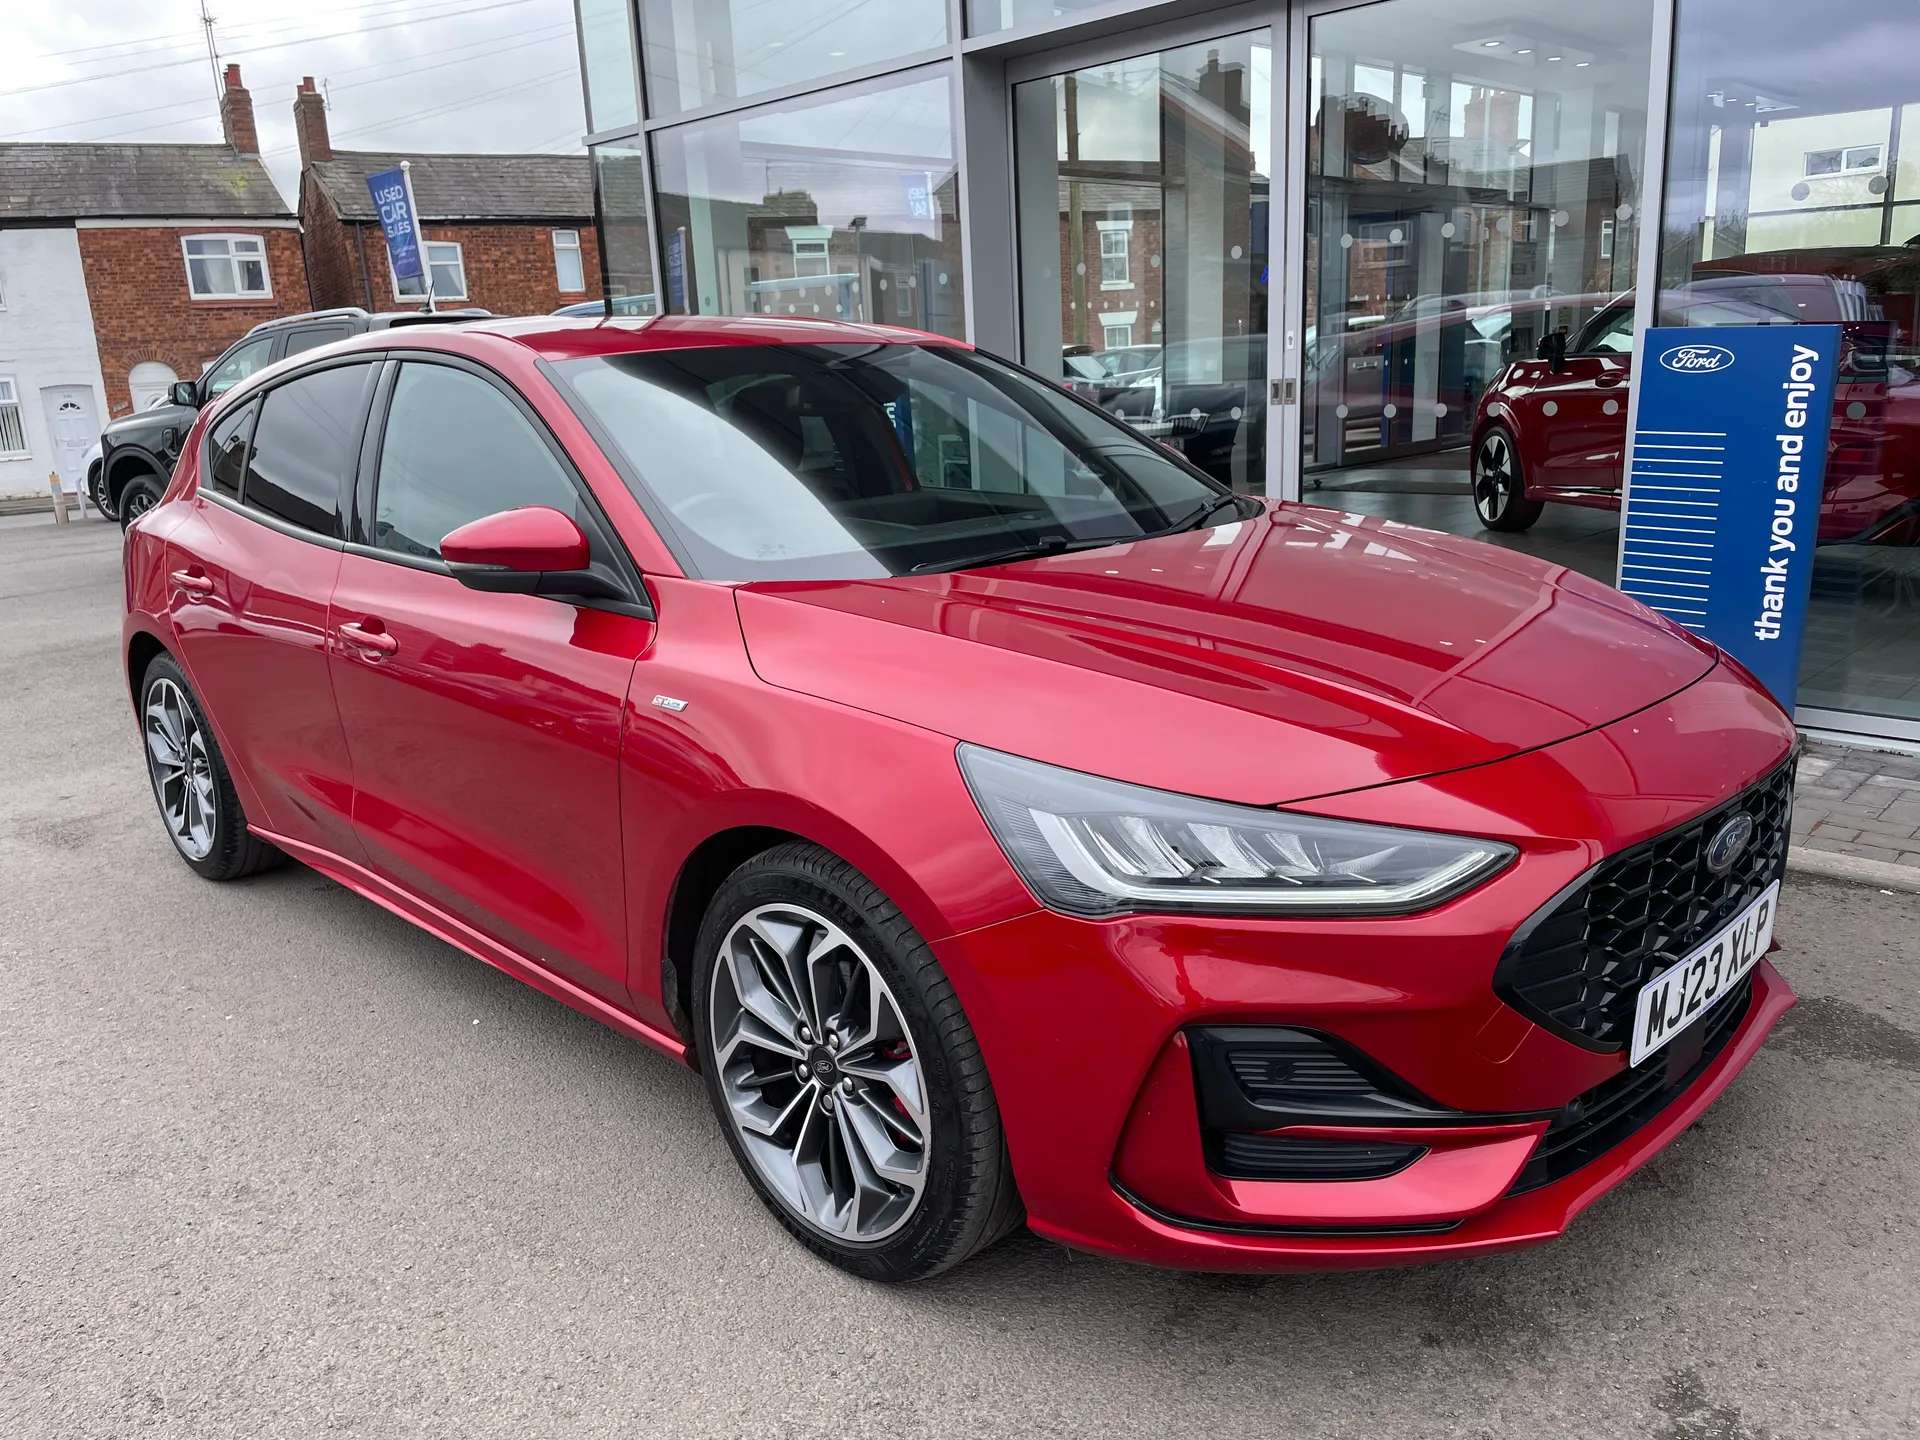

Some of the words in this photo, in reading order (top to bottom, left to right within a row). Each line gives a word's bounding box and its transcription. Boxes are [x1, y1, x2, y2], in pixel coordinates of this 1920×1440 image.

[375, 185, 404, 205] USED
[381, 201, 408, 224] CAR
[1672, 348, 1722, 369] Ford
[1782, 343, 1820, 429] enjoy
[1776, 434, 1804, 493] and
[1769, 498, 1796, 552] you
[1753, 556, 1789, 641] thank
[1645, 942, 1724, 1048] MJ23
[1725, 899, 1770, 983] XLP
